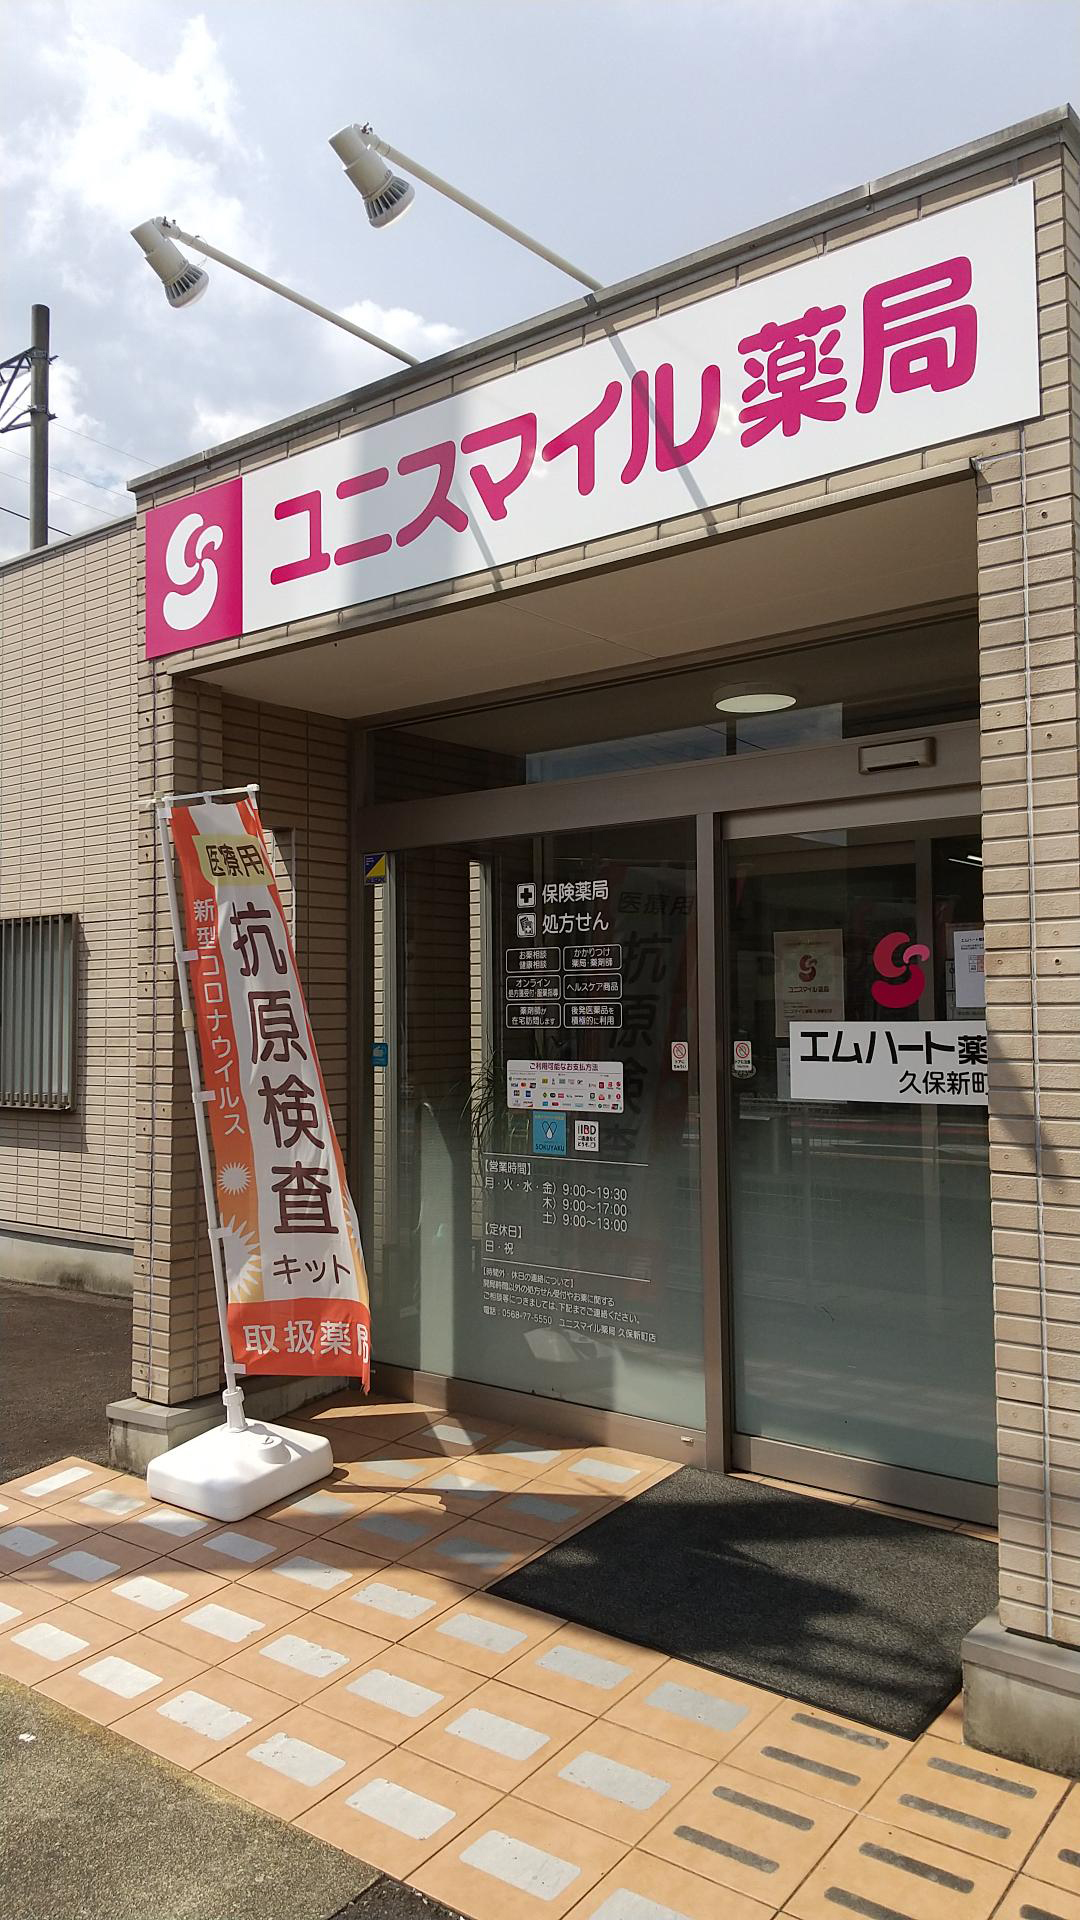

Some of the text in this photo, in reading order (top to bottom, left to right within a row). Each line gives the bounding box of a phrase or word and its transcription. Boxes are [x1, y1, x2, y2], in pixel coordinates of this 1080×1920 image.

[270, 256, 978, 586] ユニスマイル薬局
[205, 843, 265, 877] 医療用
[542, 879, 609, 904] 保険薬局
[542, 911, 609, 935] 処方せん
[573, 947, 611, 958] かかりつけ
[515, 978, 551, 988] オンライン
[566, 981, 619, 992] ヘルスケア商品
[193, 897, 246, 1137] 新型コロナウイルス
[571, 1005, 615, 1015] 後発医薬品を
[511, 1016, 556, 1026] 在宅訪問します
[229, 901, 340, 1234] 抗原検査
[535, 1143, 565, 1152] SOKUYAKU
[485, 1159, 531, 1176] 【営業時間】
[485, 1222, 522, 1239] 【定休日】
[485, 1239, 514, 1255] 日・祝
[273, 1254, 351, 1285] キット
